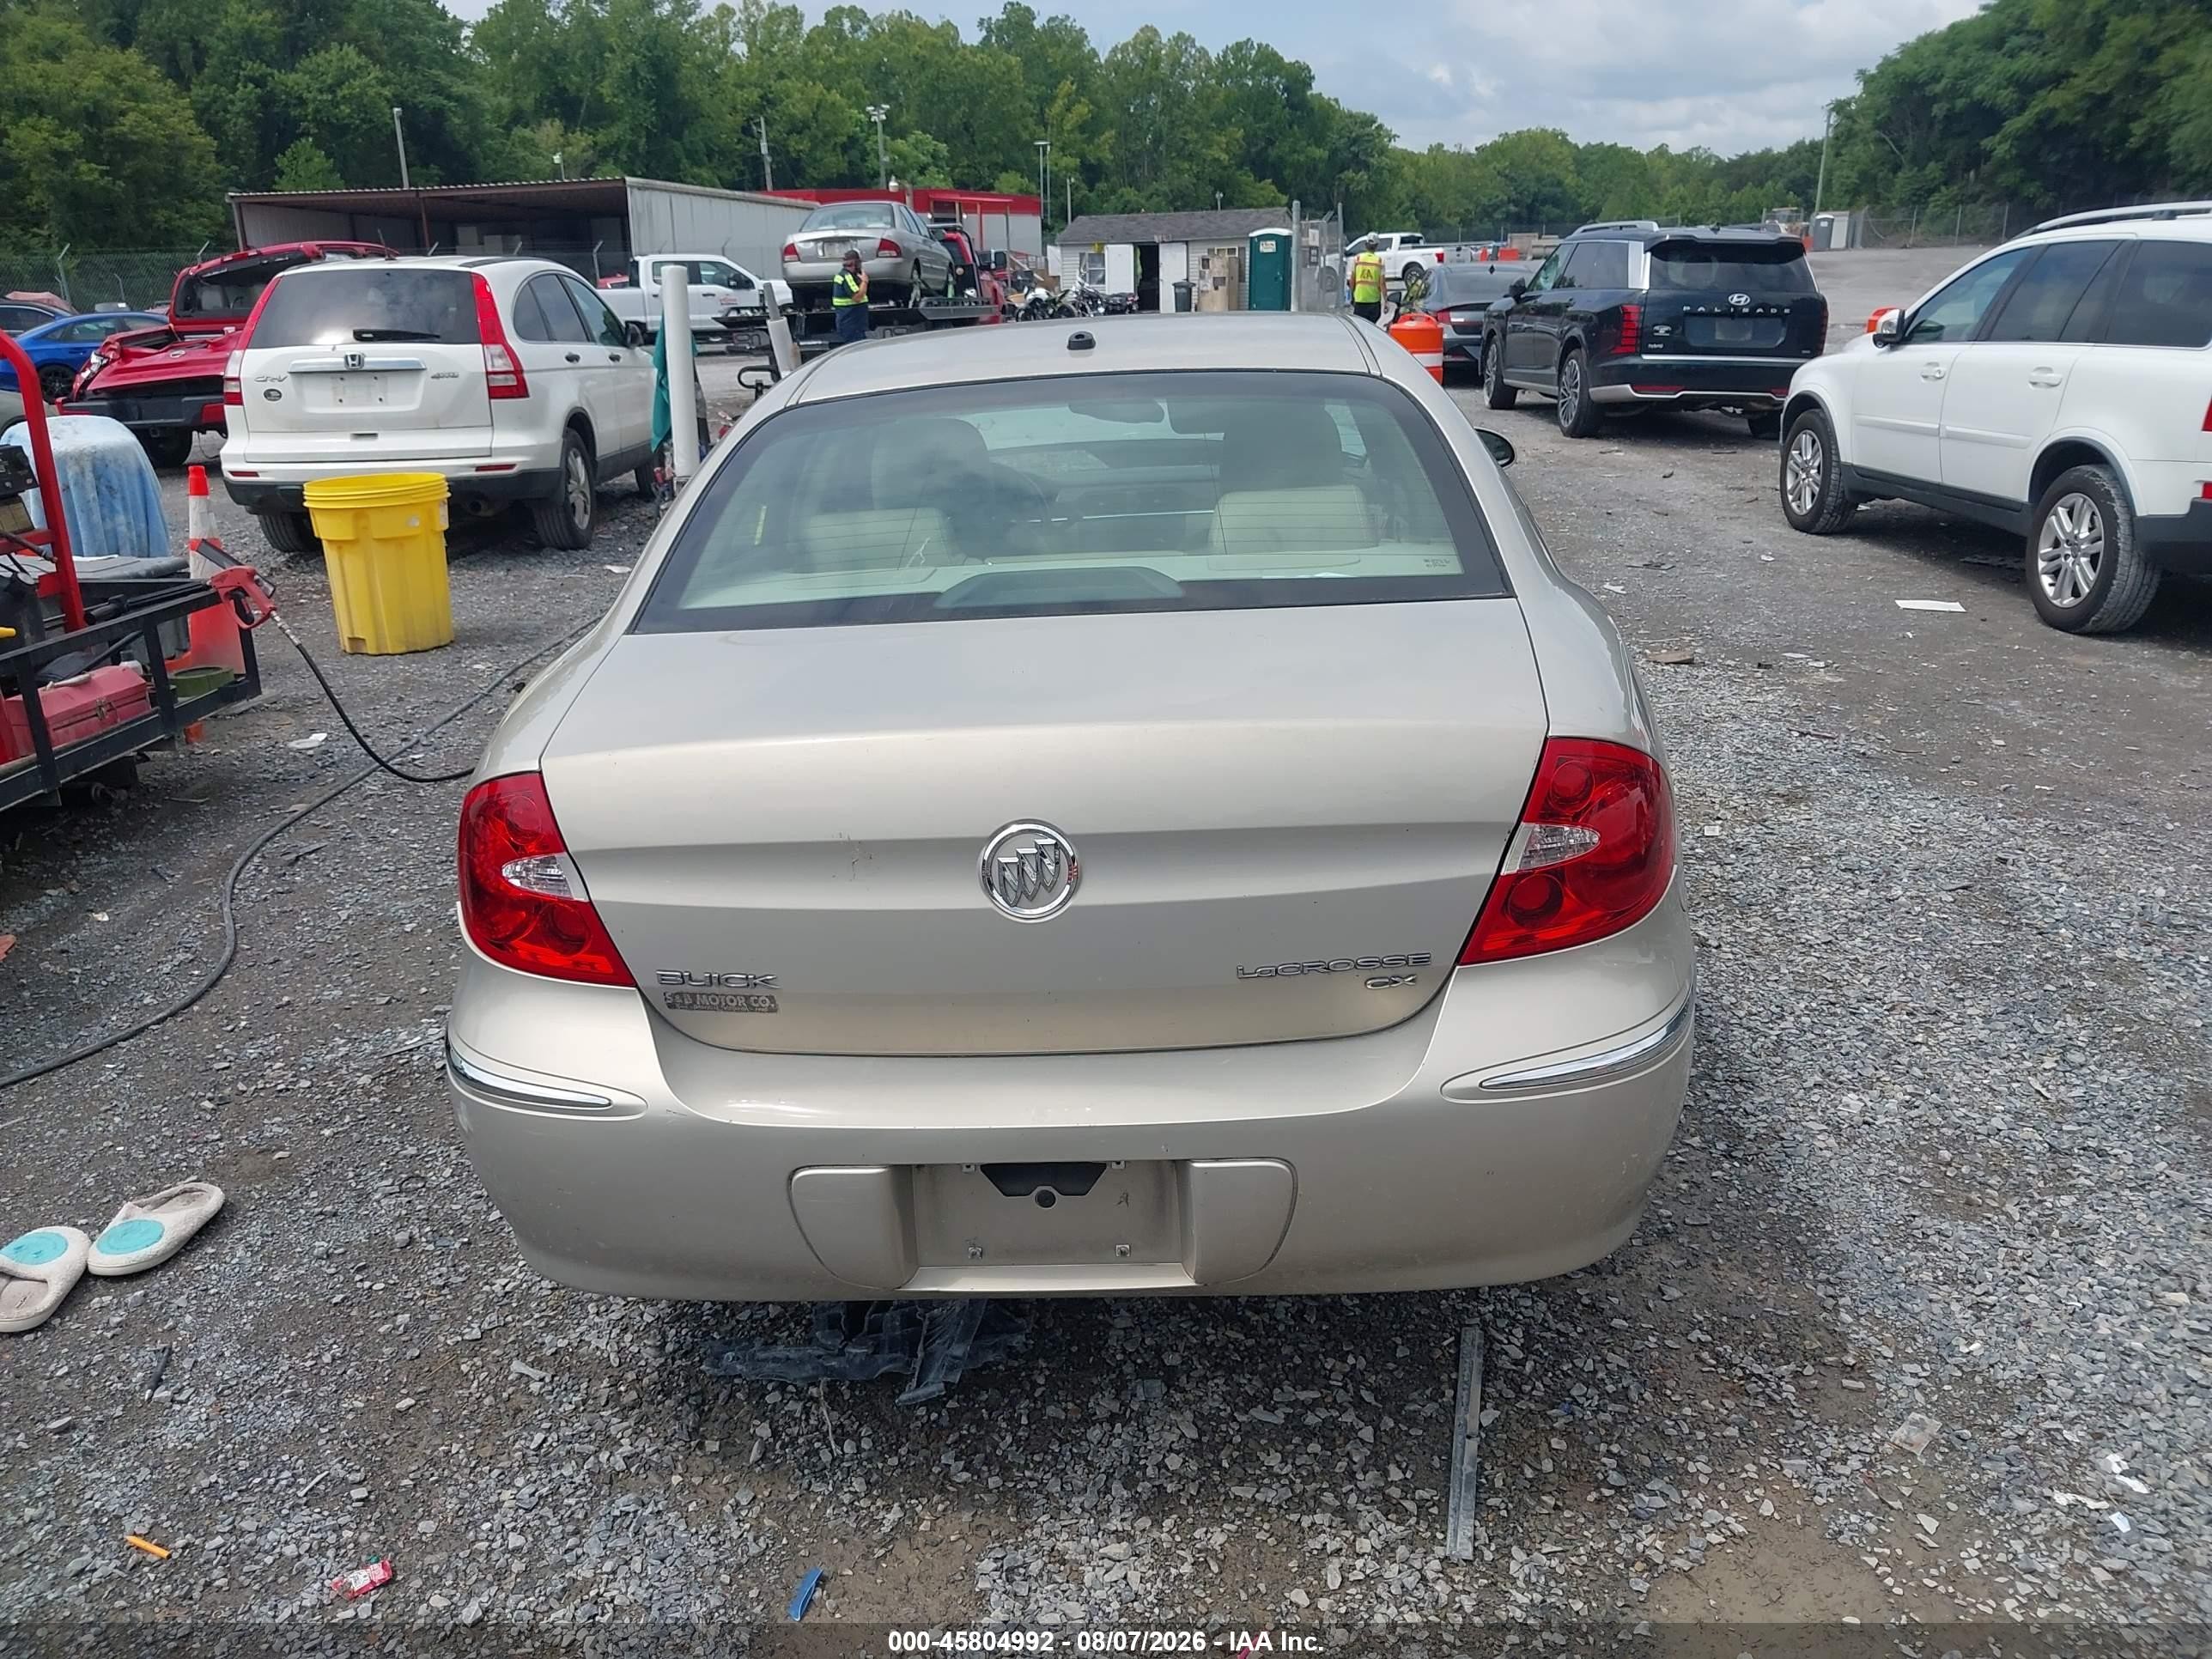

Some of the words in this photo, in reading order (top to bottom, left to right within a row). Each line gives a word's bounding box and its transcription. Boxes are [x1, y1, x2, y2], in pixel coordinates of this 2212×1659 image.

[1682, 306, 1792, 314] PALISADE
[655, 969, 782, 989] BUICK
[1364, 974, 1417, 989] CX
[696, 994, 746, 1006] MOTOR
